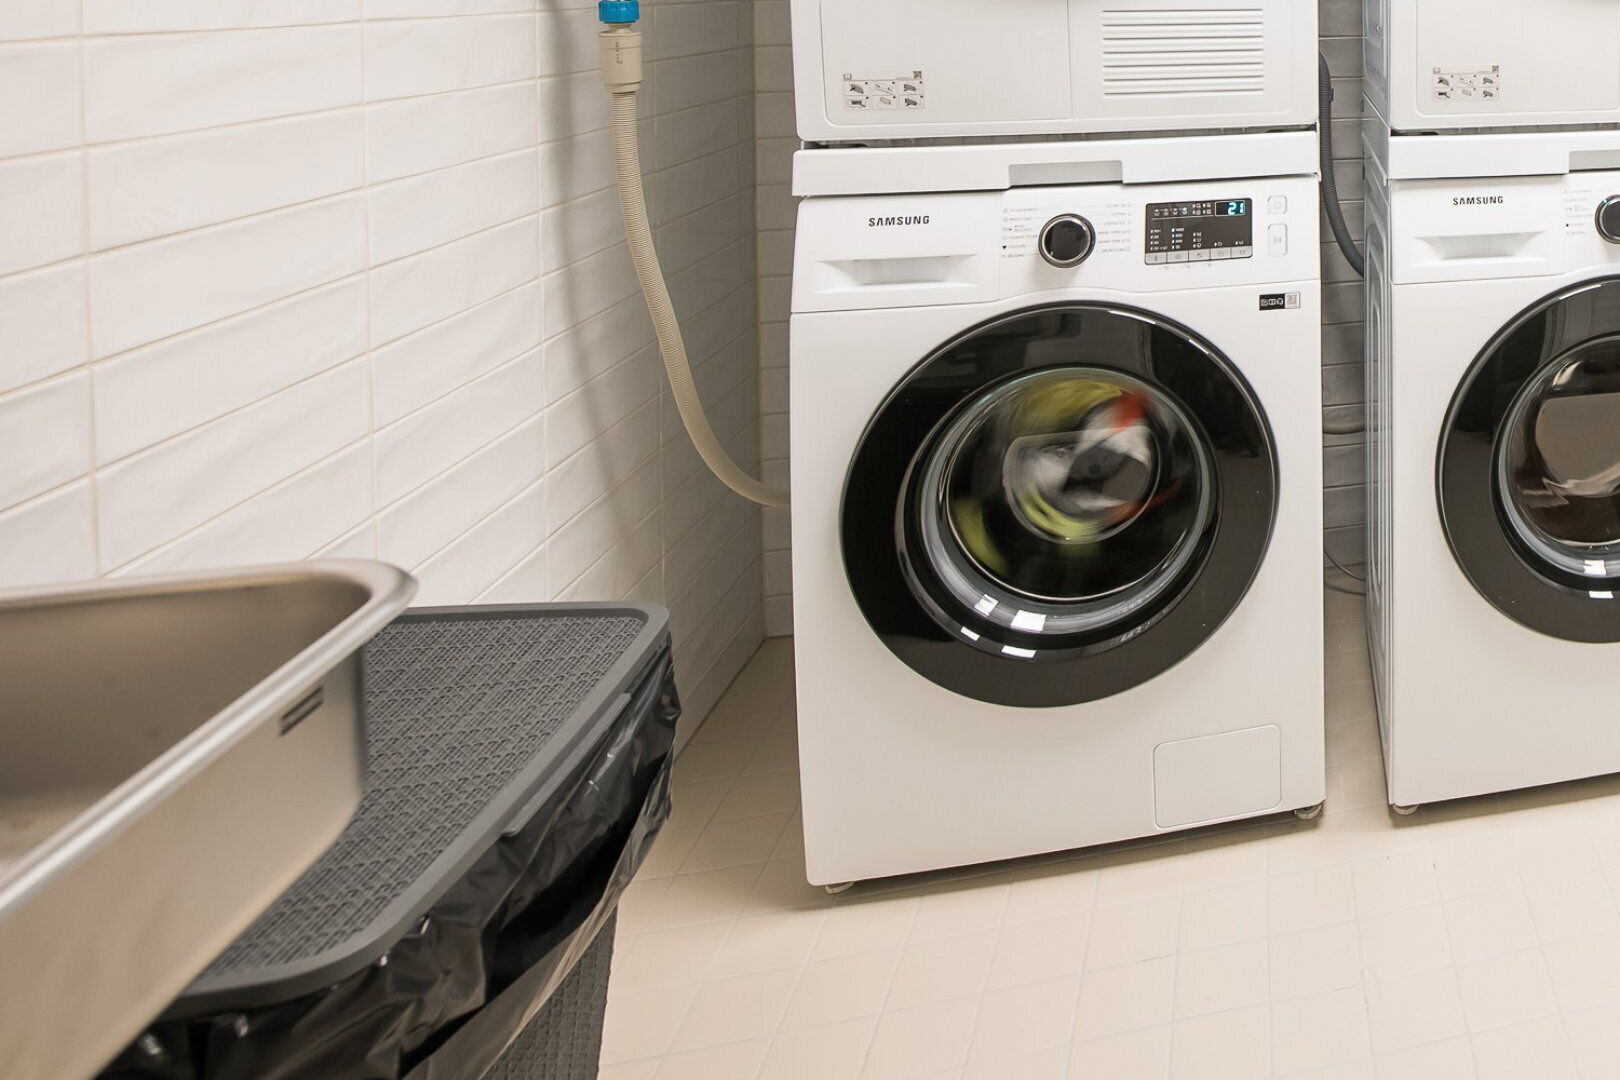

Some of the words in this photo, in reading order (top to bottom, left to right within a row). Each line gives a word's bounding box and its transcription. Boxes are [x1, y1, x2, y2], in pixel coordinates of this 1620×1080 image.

[1453, 195, 1503, 206] SAMSUNG
[1227, 202, 1244, 216] 21
[868, 215, 930, 227] SAMSUNG
